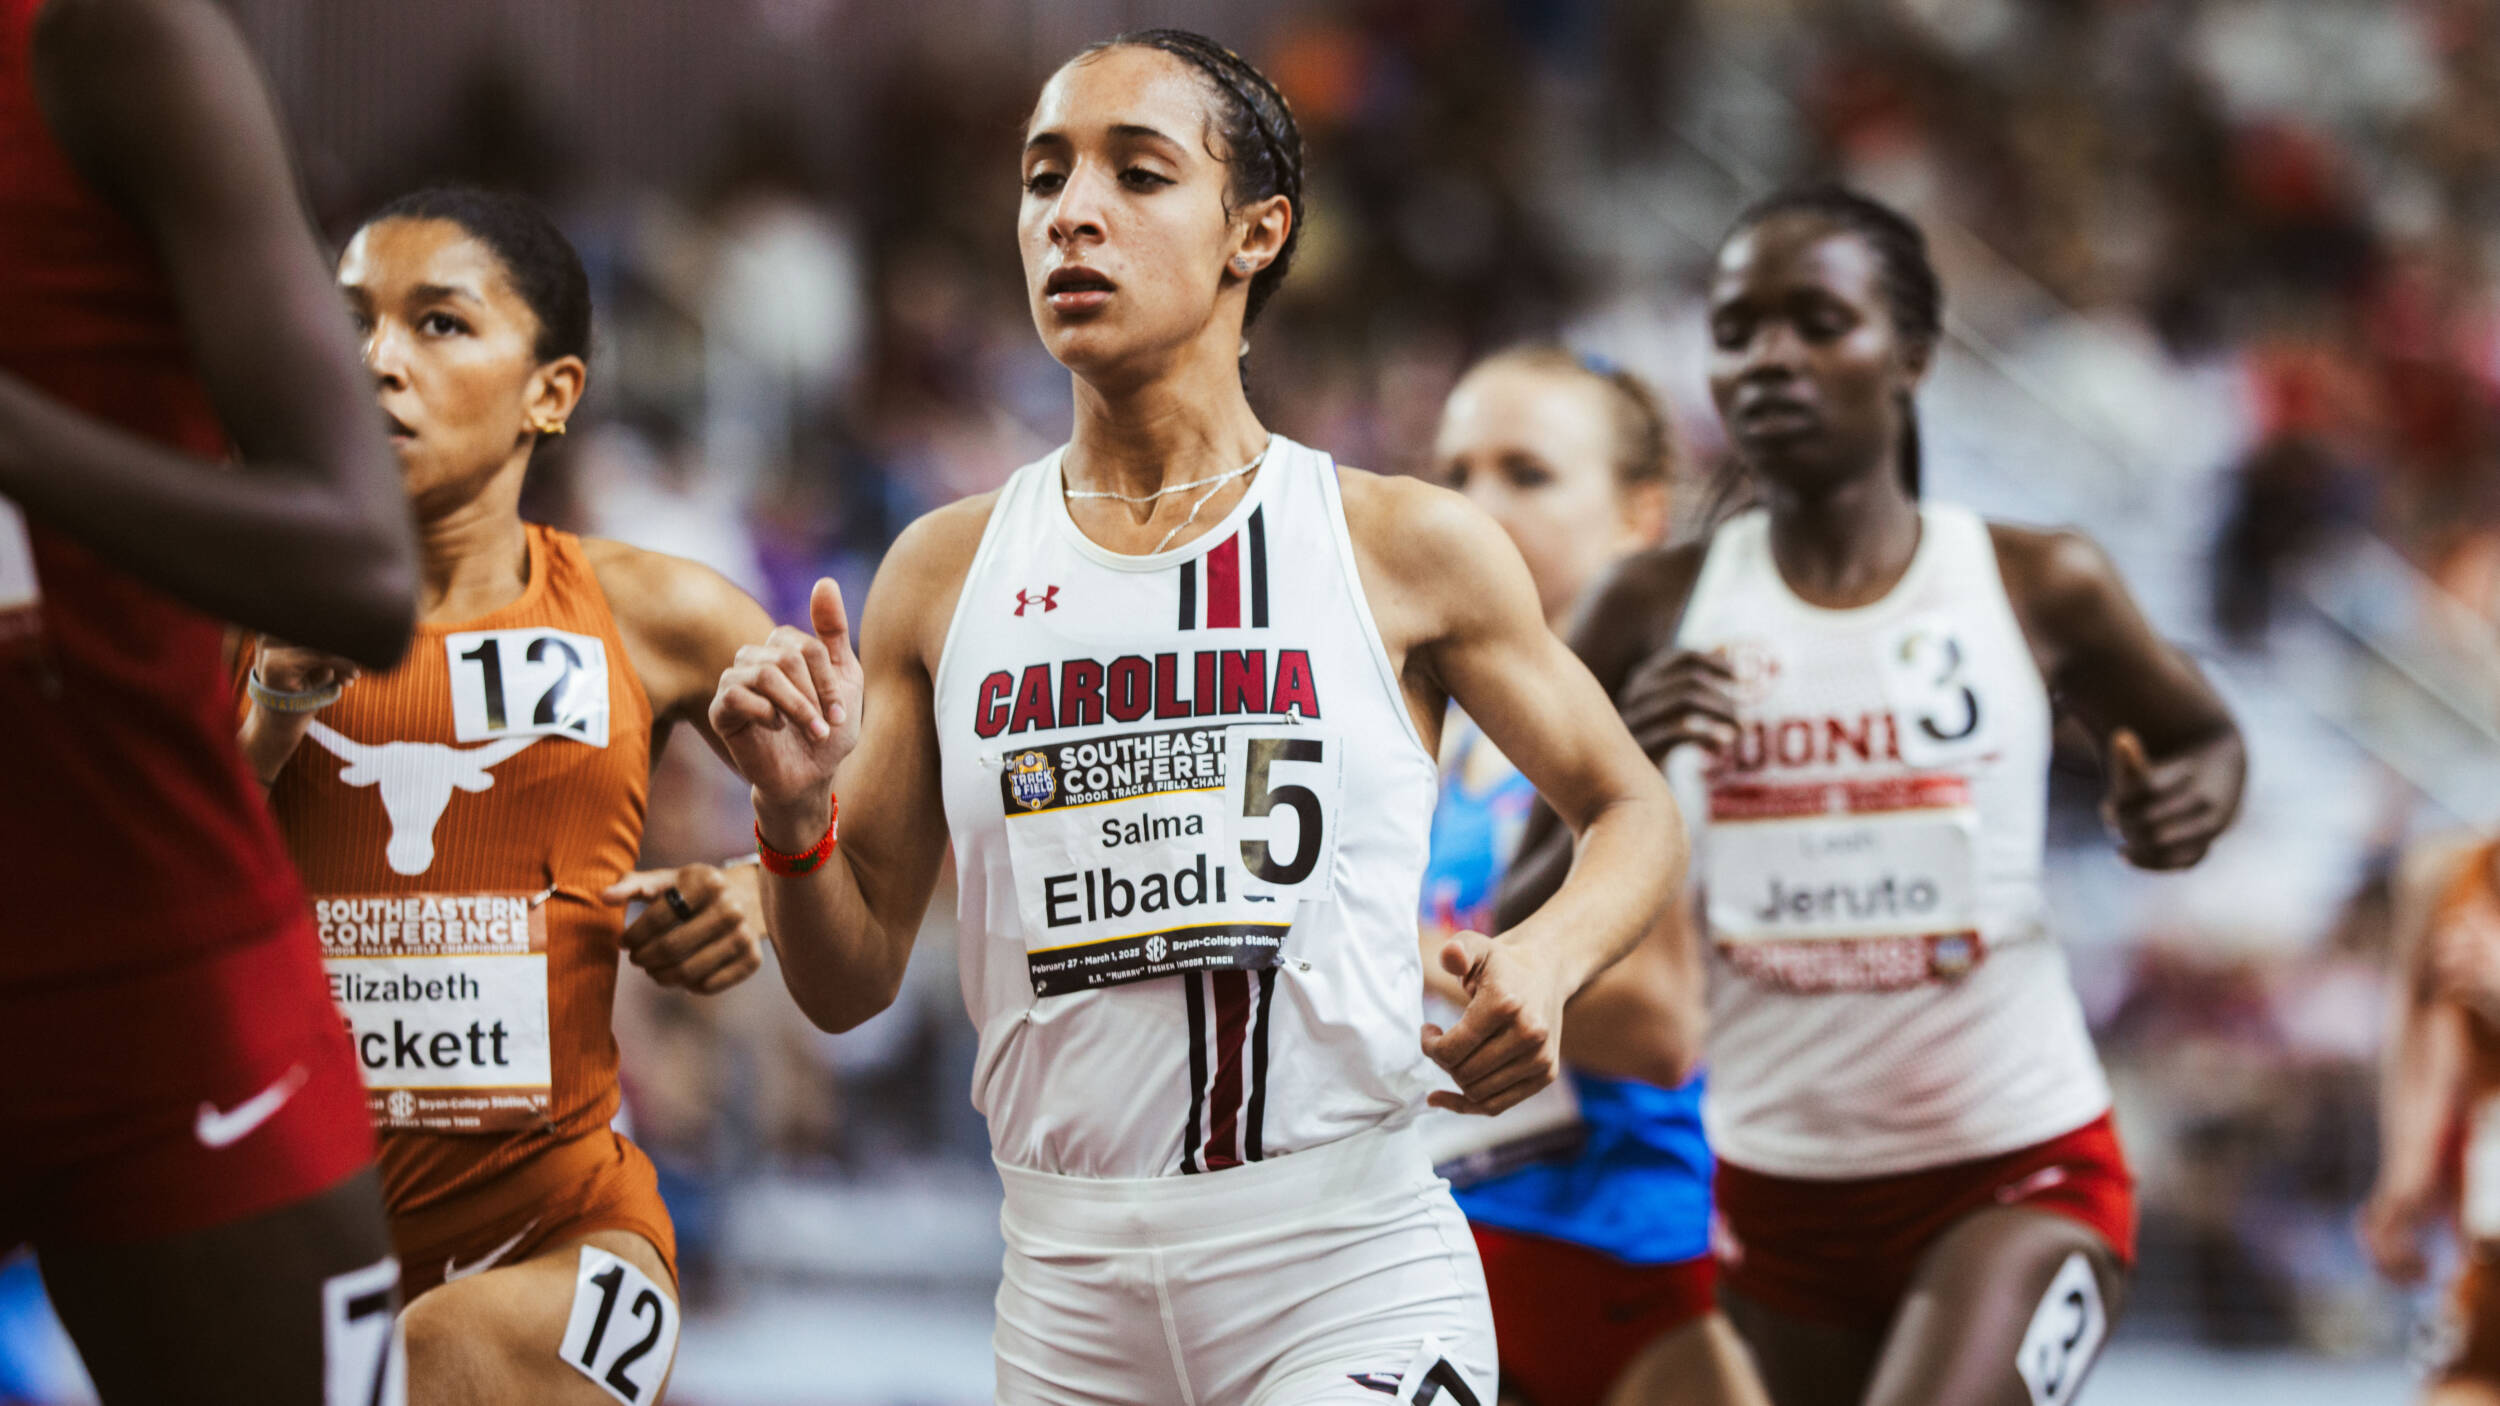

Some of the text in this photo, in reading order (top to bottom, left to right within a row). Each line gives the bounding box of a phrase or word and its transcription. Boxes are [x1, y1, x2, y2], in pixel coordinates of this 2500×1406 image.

[461, 637, 586, 733] 12
[974, 648, 1319, 739] CAROLINA
[1898, 637, 1978, 741] 3
[1065, 790, 1109, 805] INDOOR
[1112, 785, 1144, 798] TRACK
[1157, 779, 1188, 791] FIELD
[1240, 738, 1323, 885] 5
[1102, 813, 1203, 847] Salma
[316, 896, 528, 923] SOUTHEASTERN
[1755, 876, 1940, 922] Jeruto
[318, 921, 529, 946] CONFERENCE
[1145, 935, 1168, 963] SEC
[1172, 936, 1244, 951] Bryan-College
[1031, 961, 1066, 975] February
[1067, 958, 1078, 969] 27
[1085, 952, 1110, 967] March
[1111, 951, 1118, 962] 1,
[1119, 947, 1140, 960] 2025
[327, 972, 480, 1003] Elizabeth
[580, 1264, 663, 1405] 12
